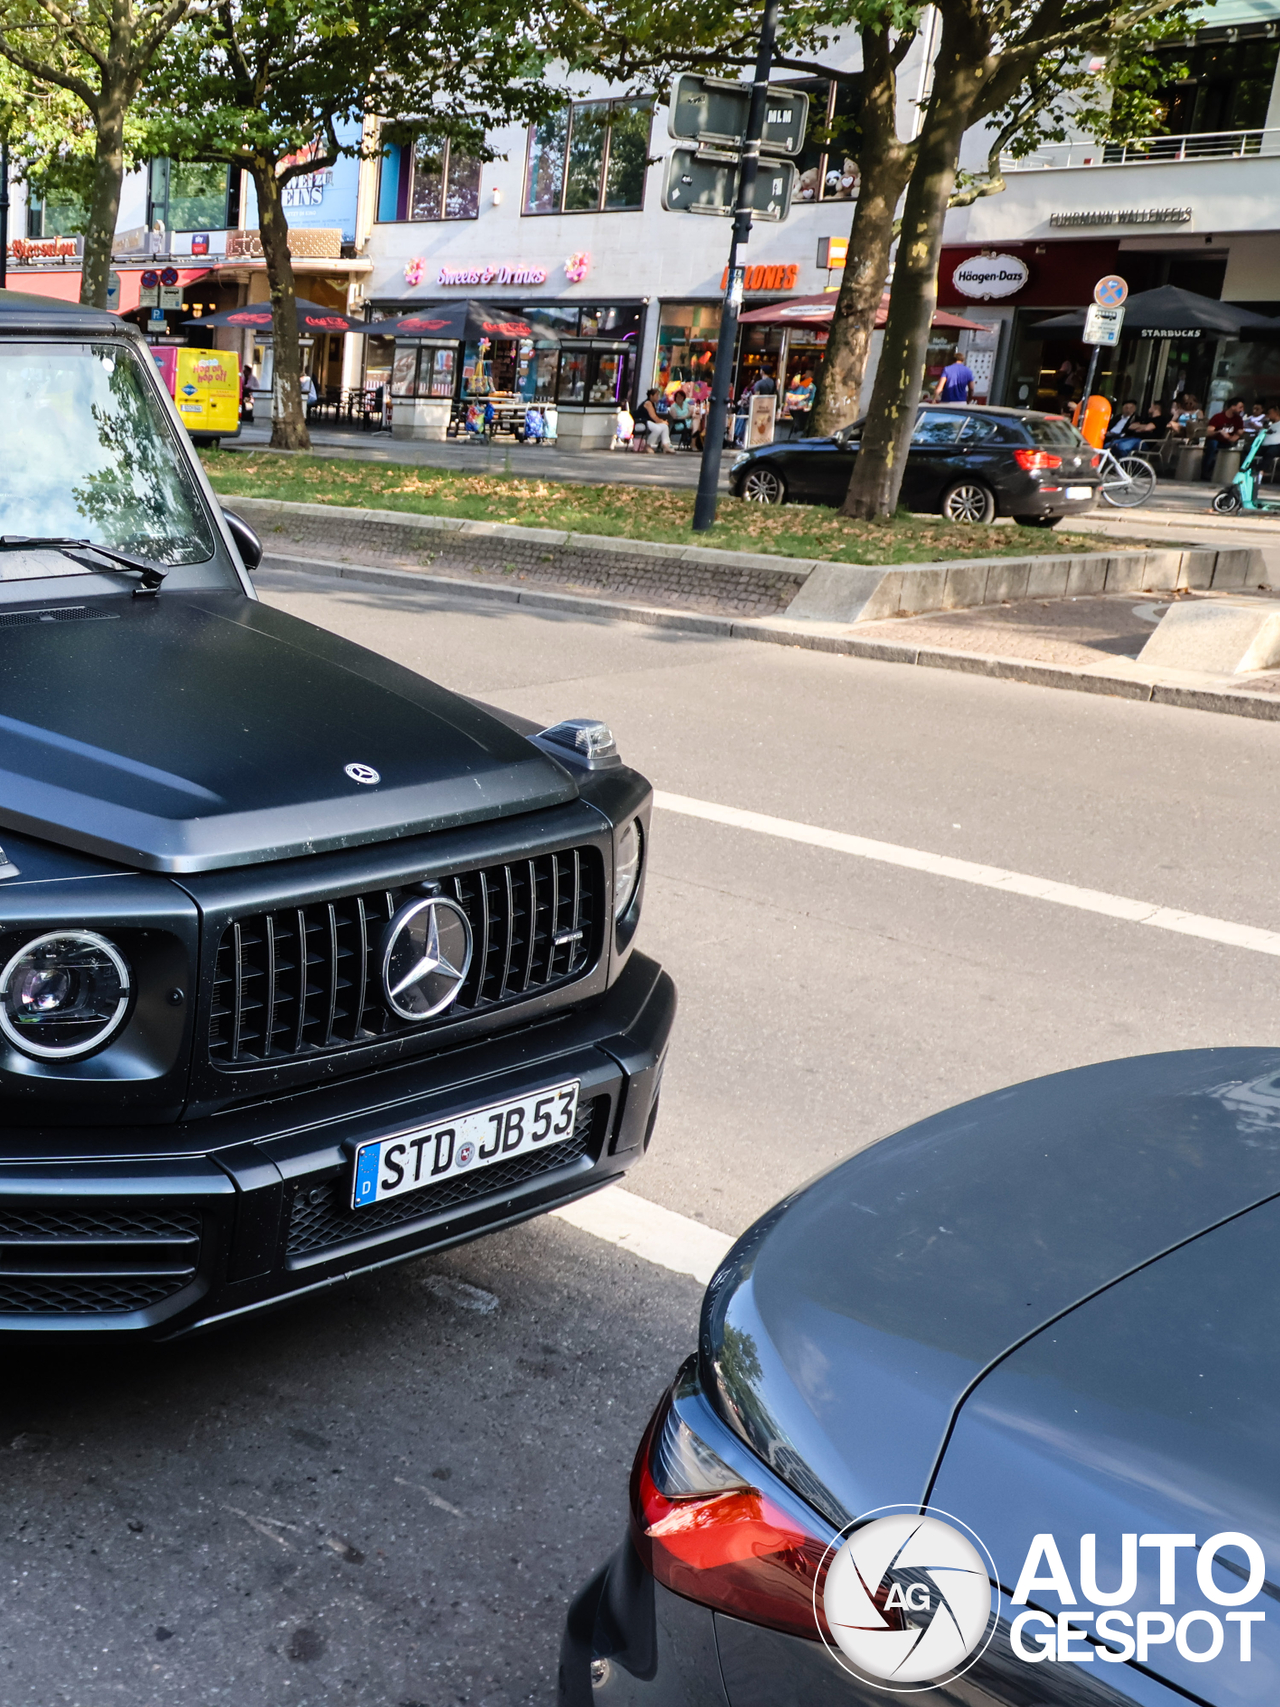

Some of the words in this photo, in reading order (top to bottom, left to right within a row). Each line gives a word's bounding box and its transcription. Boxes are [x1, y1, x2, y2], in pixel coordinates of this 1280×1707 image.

[283, 173, 314, 189] WEI
[281, 187, 323, 206] EINS
[1050, 211, 1113, 227] FUHRMANN
[437, 267, 480, 285] Sweets
[481, 265, 494, 284] &
[498, 265, 546, 284] Drinks
[720, 264, 799, 290] LONES
[958, 270, 1023, 284] Häagen-Dazs
[1141, 329, 1201, 337] STARBUCKS
[381, 1128, 456, 1191] STD
[478, 1106, 526, 1160] JB
[531, 1090, 576, 1142] 53
[362, 1181, 371, 1195] D
